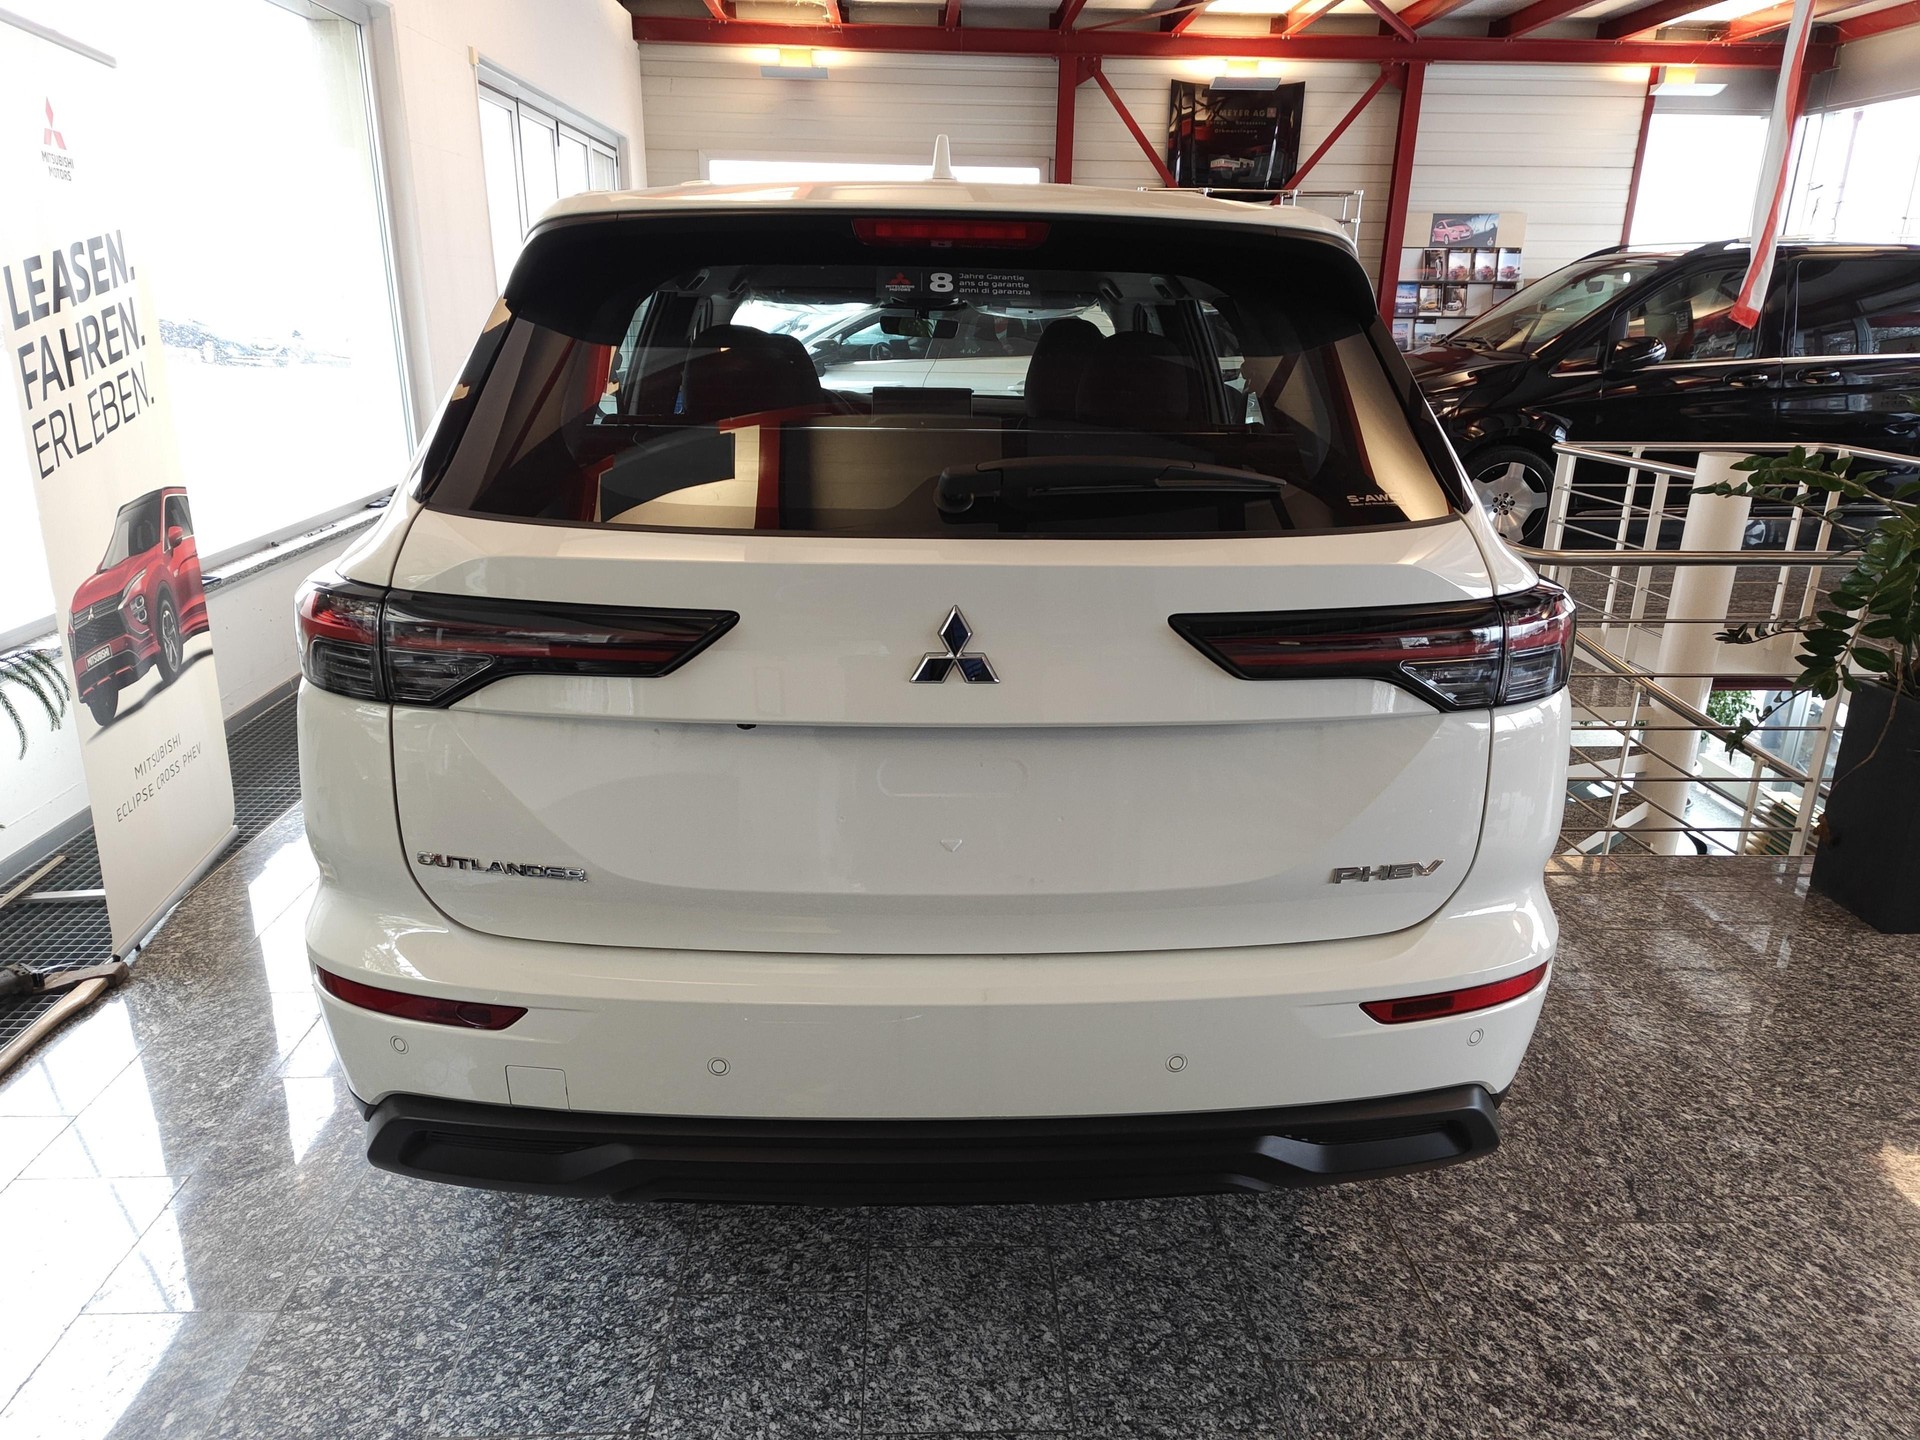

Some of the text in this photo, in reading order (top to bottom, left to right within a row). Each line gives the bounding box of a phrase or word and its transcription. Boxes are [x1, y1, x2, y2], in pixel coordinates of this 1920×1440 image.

[1218, 108, 1250, 117] MEYER
[1252, 109, 1266, 117] AG
[41, 150, 75, 169] MITSUBISHI
[48, 166, 72, 182] MOTORS
[3, 229, 136, 331] LEASEN.
[929, 272, 954, 293] 8
[959, 272, 1025, 282] Jahre Garantie
[991, 281, 1030, 289] garantie
[992, 288, 1031, 296] garanzia
[17, 296, 146, 411] FAHREN.
[31, 361, 155, 480] ERLEBEN.
[134, 733, 181, 780] MITSUBISHI
[116, 741, 201, 823] ECLIPSE CROSS PHEV
[416, 850, 588, 883] OUTLANDER
[1329, 859, 1446, 884] PHEV
